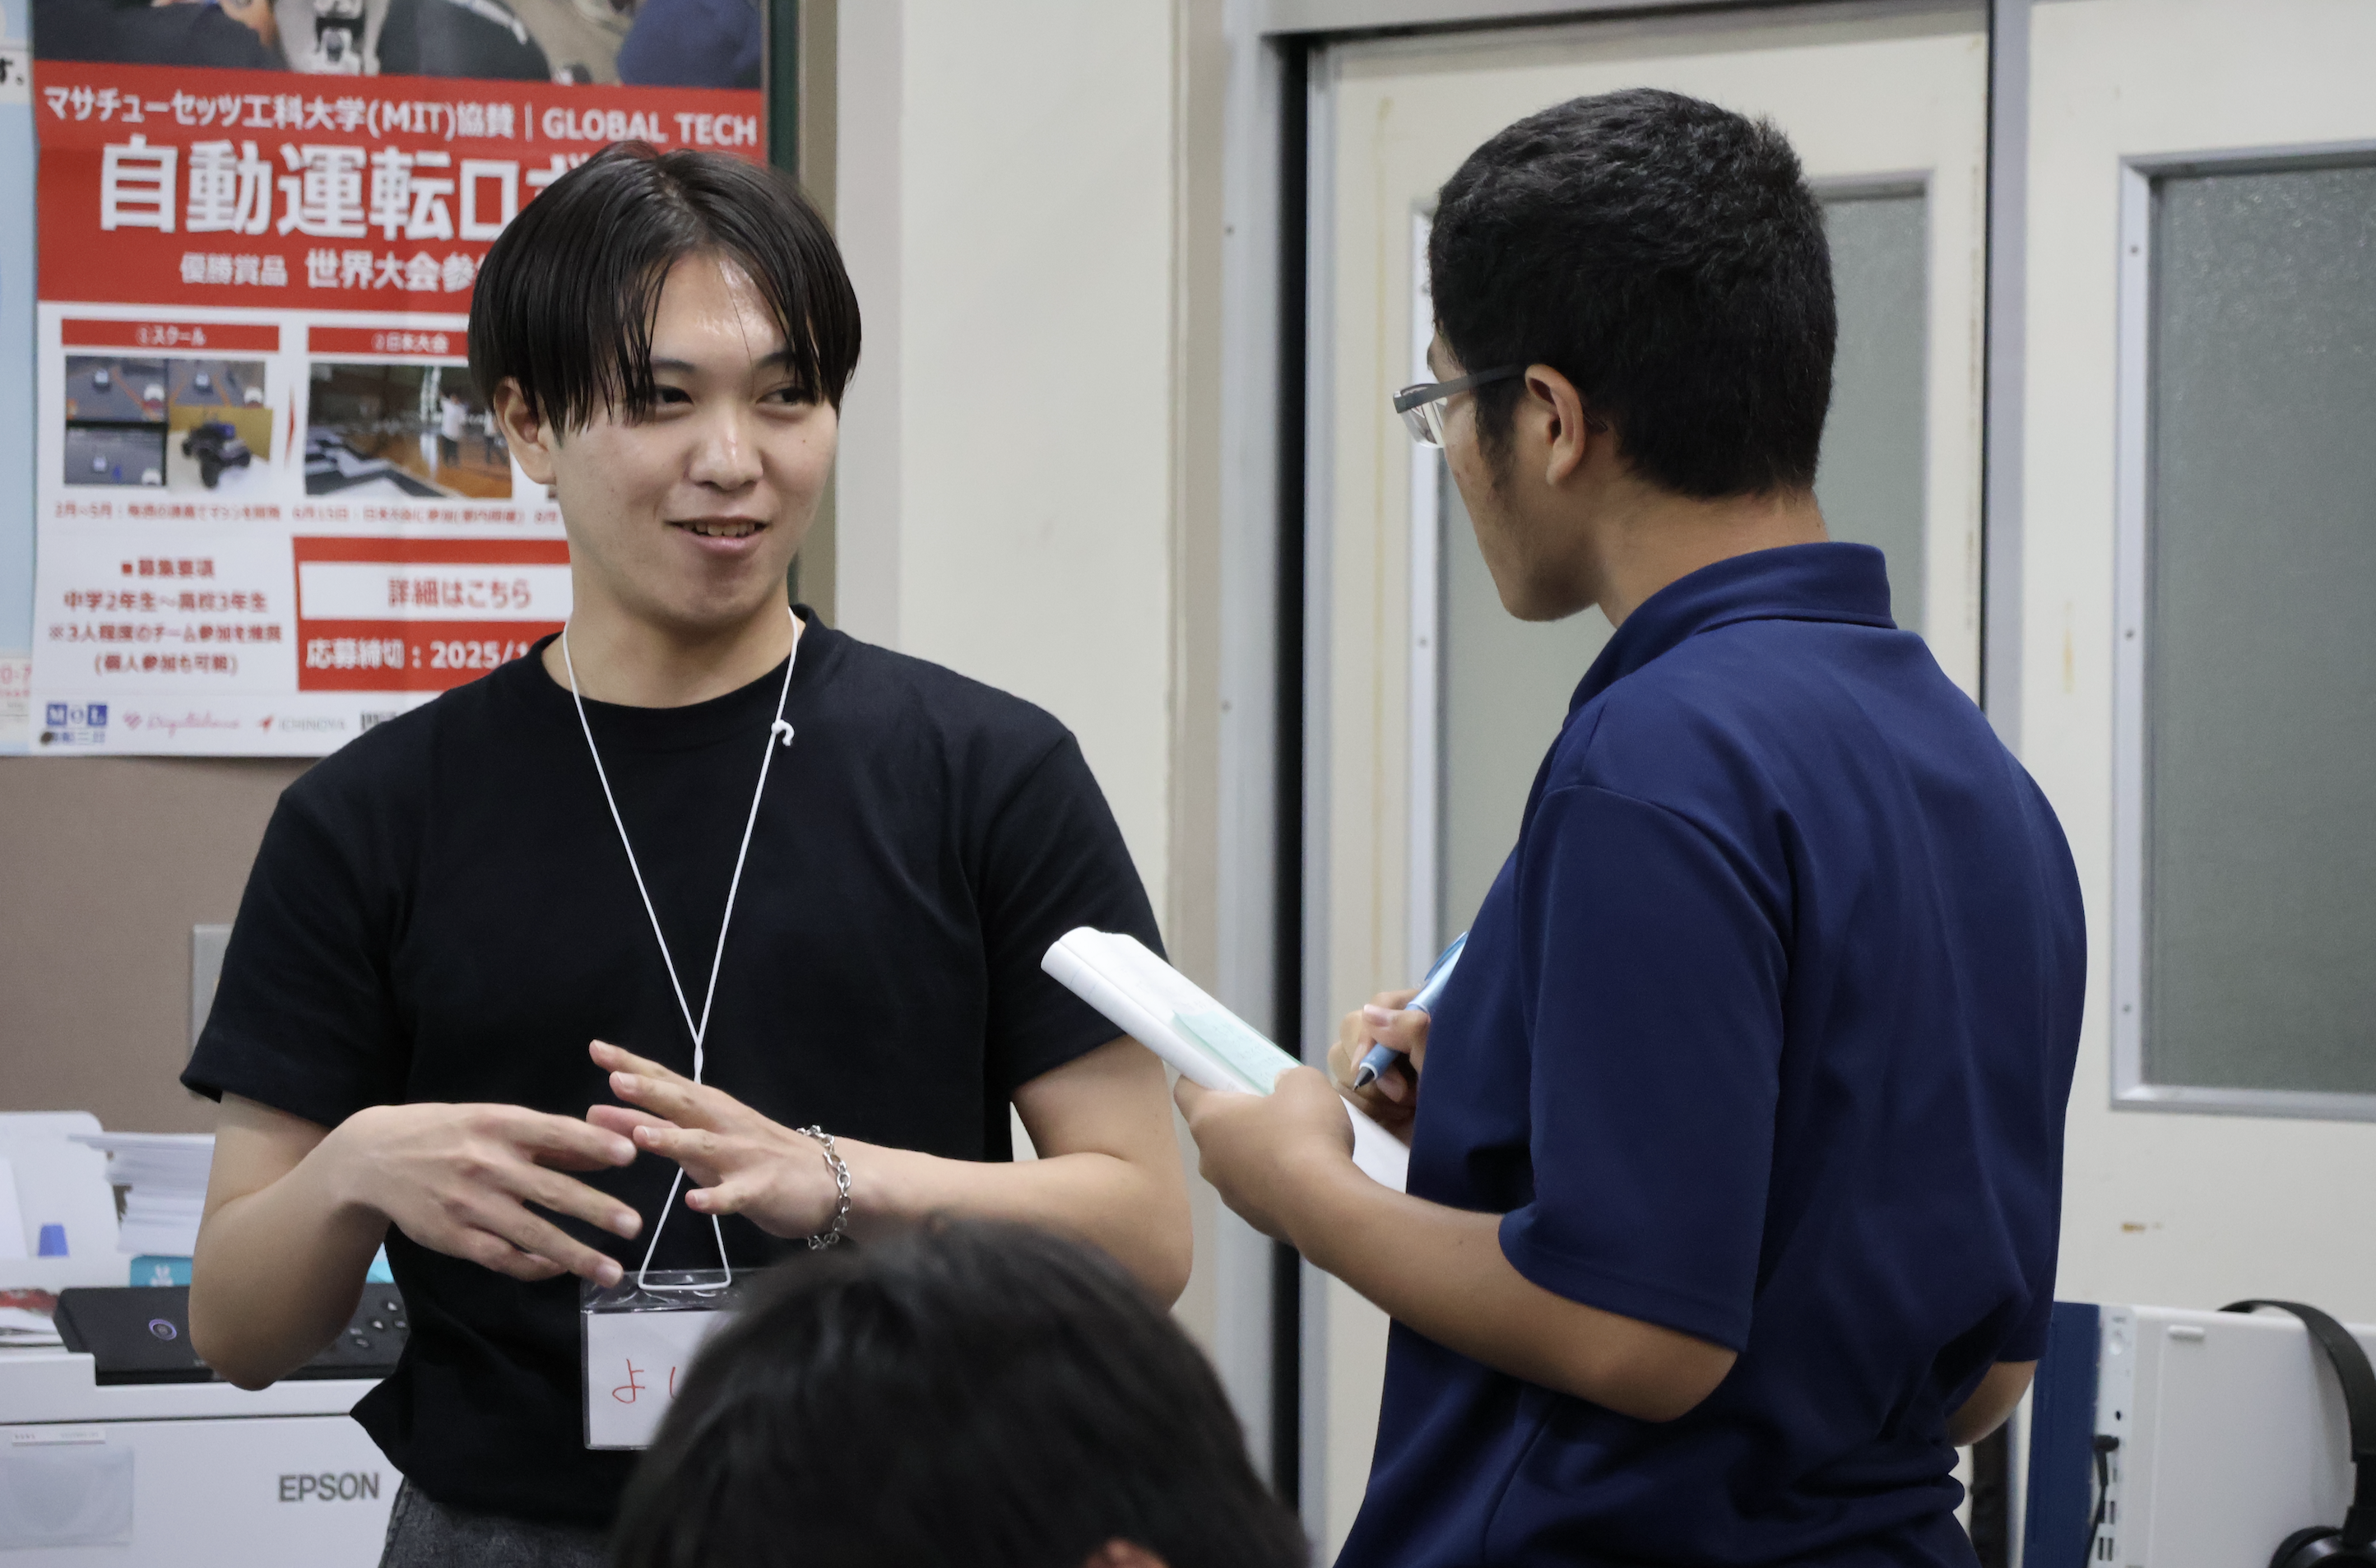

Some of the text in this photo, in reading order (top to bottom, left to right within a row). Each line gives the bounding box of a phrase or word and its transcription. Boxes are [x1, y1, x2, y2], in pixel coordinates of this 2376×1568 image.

[541, 108, 668, 142] GLOBAL
[675, 113, 758, 146] TECH
[180, 249, 485, 293] 優勝賞品 世界大会参
[387, 578, 531, 609] 詳細はこちら
[279, 1473, 379, 1501] EPSON
